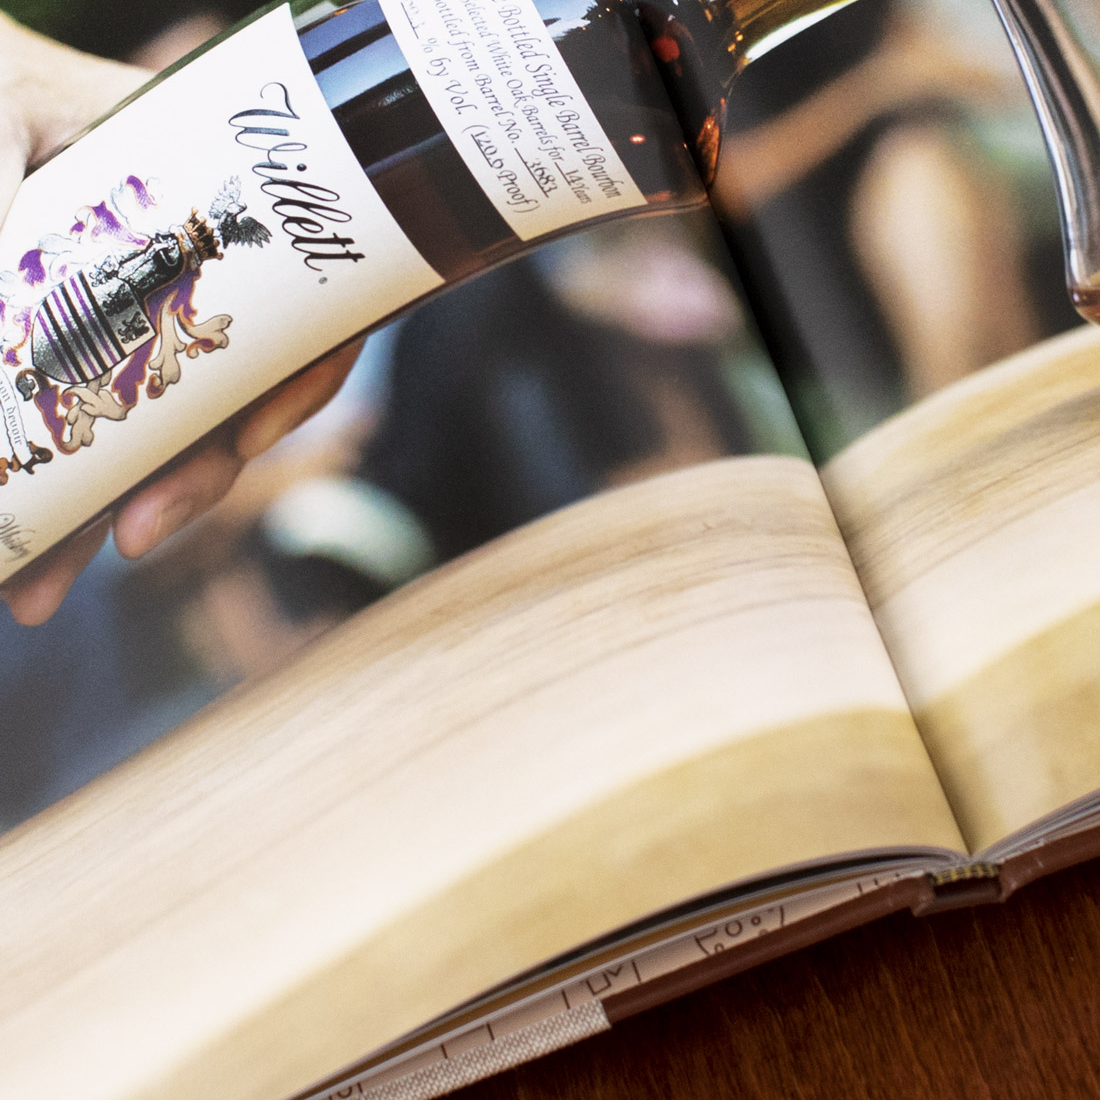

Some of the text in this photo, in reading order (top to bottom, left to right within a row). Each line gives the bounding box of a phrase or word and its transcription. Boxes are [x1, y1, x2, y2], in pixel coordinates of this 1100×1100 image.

[422, 38, 439, 53] %
[486, 42, 512, 76] White
[426, 58, 451, 76] by
[445, 80, 478, 115] Vol.
[498, 7, 550, 59] Bottled
[525, 64, 573, 107] Single
[555, 110, 600, 153] Barrel
[582, 150, 623, 198] Bourbon
[506, 79, 534, 108] Oak
[447, 40, 480, 72] from
[475, 74, 514, 117] Barrel
[498, 115, 522, 143] No.
[524, 161, 558, 196] 3683
[522, 105, 558, 145] Barrels
[537, 145, 566, 162] for
[228, 82, 366, 272] Willett
[496, 170, 540, 213] Proof)
[571, 183, 592, 204] Years
